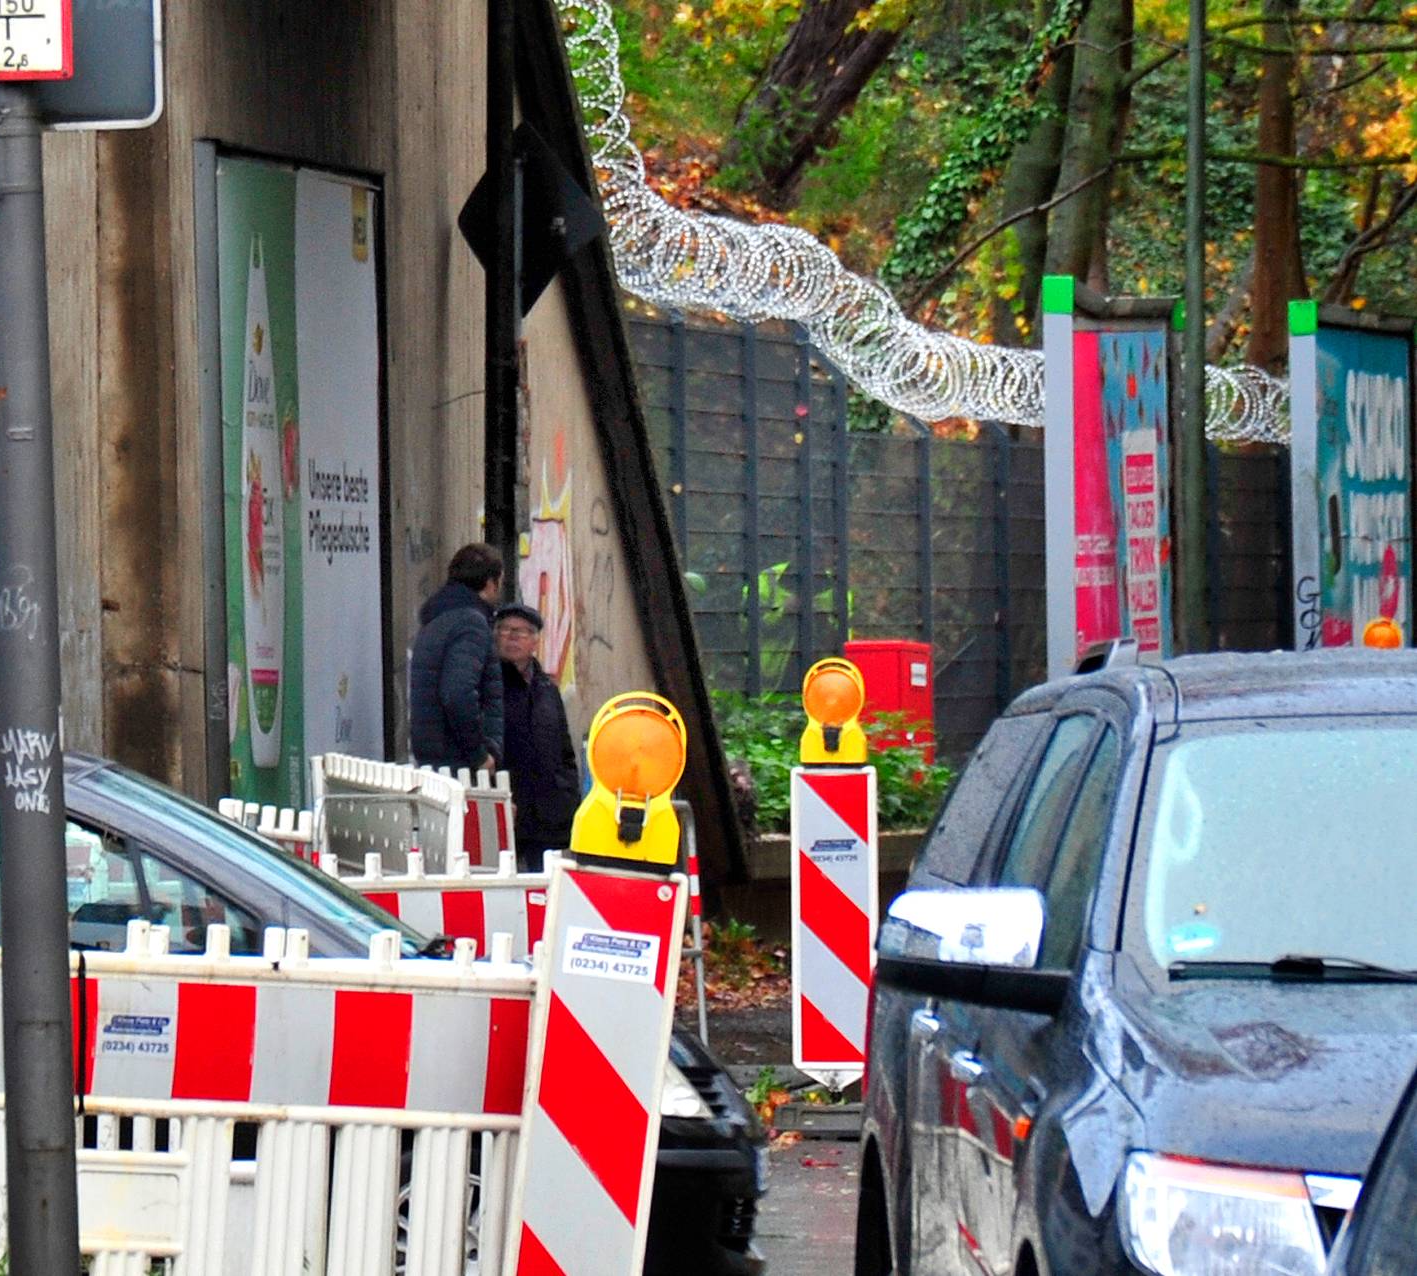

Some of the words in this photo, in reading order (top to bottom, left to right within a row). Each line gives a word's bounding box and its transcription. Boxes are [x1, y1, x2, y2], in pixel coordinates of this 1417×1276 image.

[308, 459, 341, 501] Unsere
[343, 462, 368, 503] beste
[308, 510, 370, 566] Pflegedusche
[570, 957, 609, 973] (0234)
[612, 962, 649, 976] 43725
[102, 1041, 135, 1054] (0234)
[138, 1041, 169, 1053] 43725
